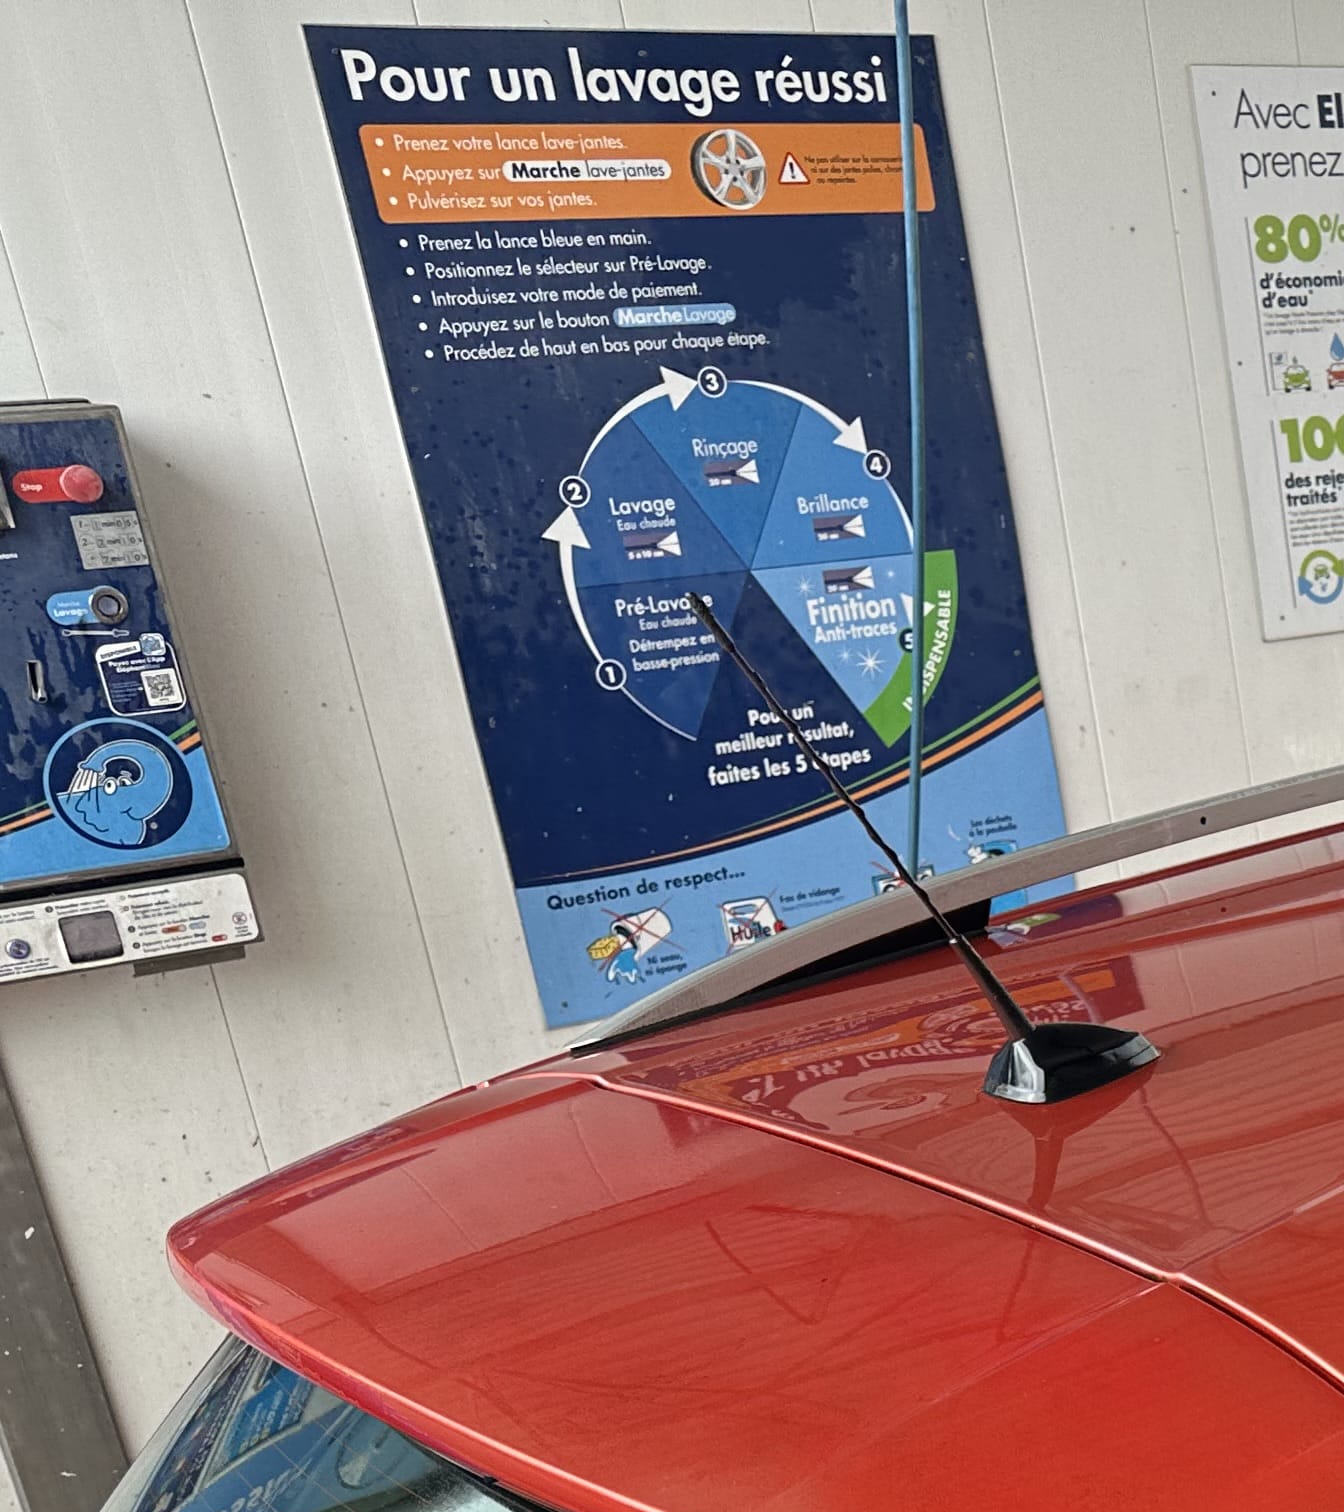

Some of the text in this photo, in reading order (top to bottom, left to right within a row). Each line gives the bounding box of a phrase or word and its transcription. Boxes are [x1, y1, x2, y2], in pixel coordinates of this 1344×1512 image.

[340, 47, 887, 117] Pour un lavage réussi
[1234, 87, 1311, 129] Avec
[393, 132, 627, 153] Prenez votre lance lave-jantes.
[402, 160, 665, 185] Appuyez sur Marche lave-jantes
[1240, 152, 1344, 189] prenez
[407, 191, 597, 212] Pulvérisez sur vos jantes.
[418, 228, 651, 251] Prenez la lance bleue en main.
[424, 254, 712, 280] Positionnez le sélecteur sur Pré-Lavage.
[431, 281, 702, 307] Introduisez votre mode de paiement.
[439, 306, 735, 339] Appuyez sur le bouton Marche Lavage
[444, 331, 770, 361] Procédez de haut en bas pour chaque étape.
[704, 373, 720, 391] 3
[692, 438, 758, 459] Rinçage
[869, 457, 882, 473] 4
[567, 483, 583, 500] 2
[1285, 472, 1311, 489] des
[609, 497, 676, 517] Lavage
[797, 494, 869, 515] Brillance
[616, 517, 676, 531] Eau chaude
[615, 594, 712, 617] Pré-Lavae
[806, 592, 896, 626] Finition
[639, 619, 658, 631] Eau
[814, 621, 897, 643] Anti-traces
[629, 635, 697, 653] Détrempez
[902, 589, 951, 712] IISPENSABLE
[632, 651, 720, 672] basse-pression
[605, 667, 616, 683] 1
[747, 706, 814, 727] Pou un
[715, 731, 783, 755] meilleur
[707, 765, 760, 786] faites
[763, 757, 791, 777] les
[795, 754, 807, 773] 5
[547, 866, 745, 910] Question de respect...
